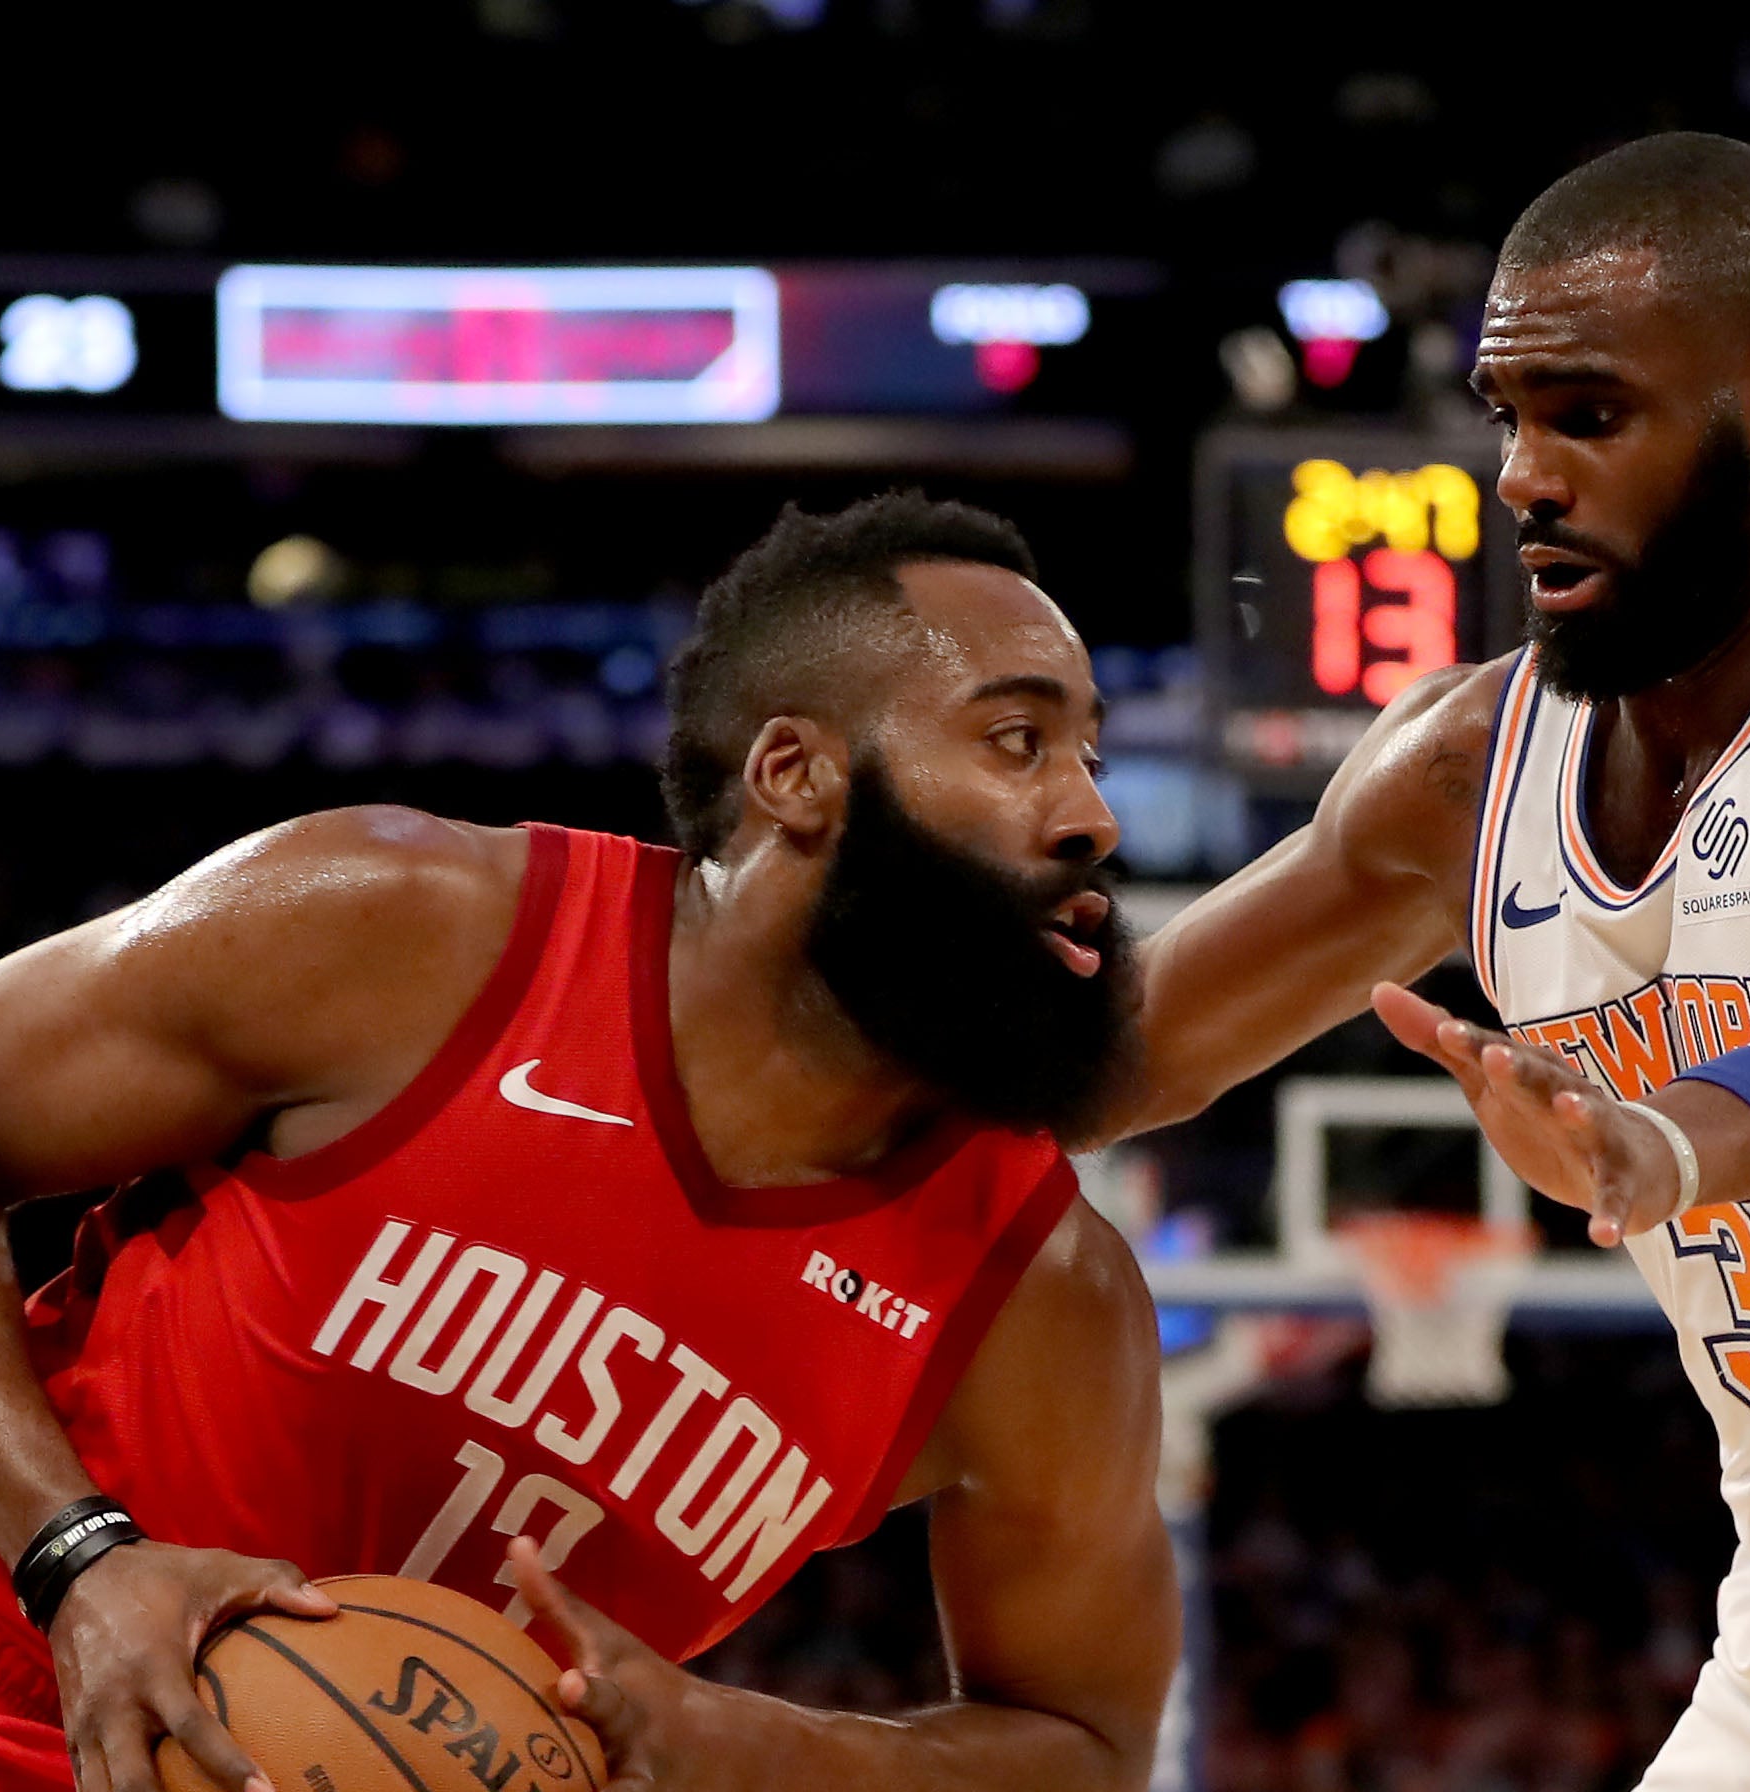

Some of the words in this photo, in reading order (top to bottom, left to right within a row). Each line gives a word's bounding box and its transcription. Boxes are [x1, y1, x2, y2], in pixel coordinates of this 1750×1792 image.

[309, 1216, 835, 1605] HOUSTON
[63, 1524, 87, 1546] HIT
[84, 1516, 107, 1533] UR
